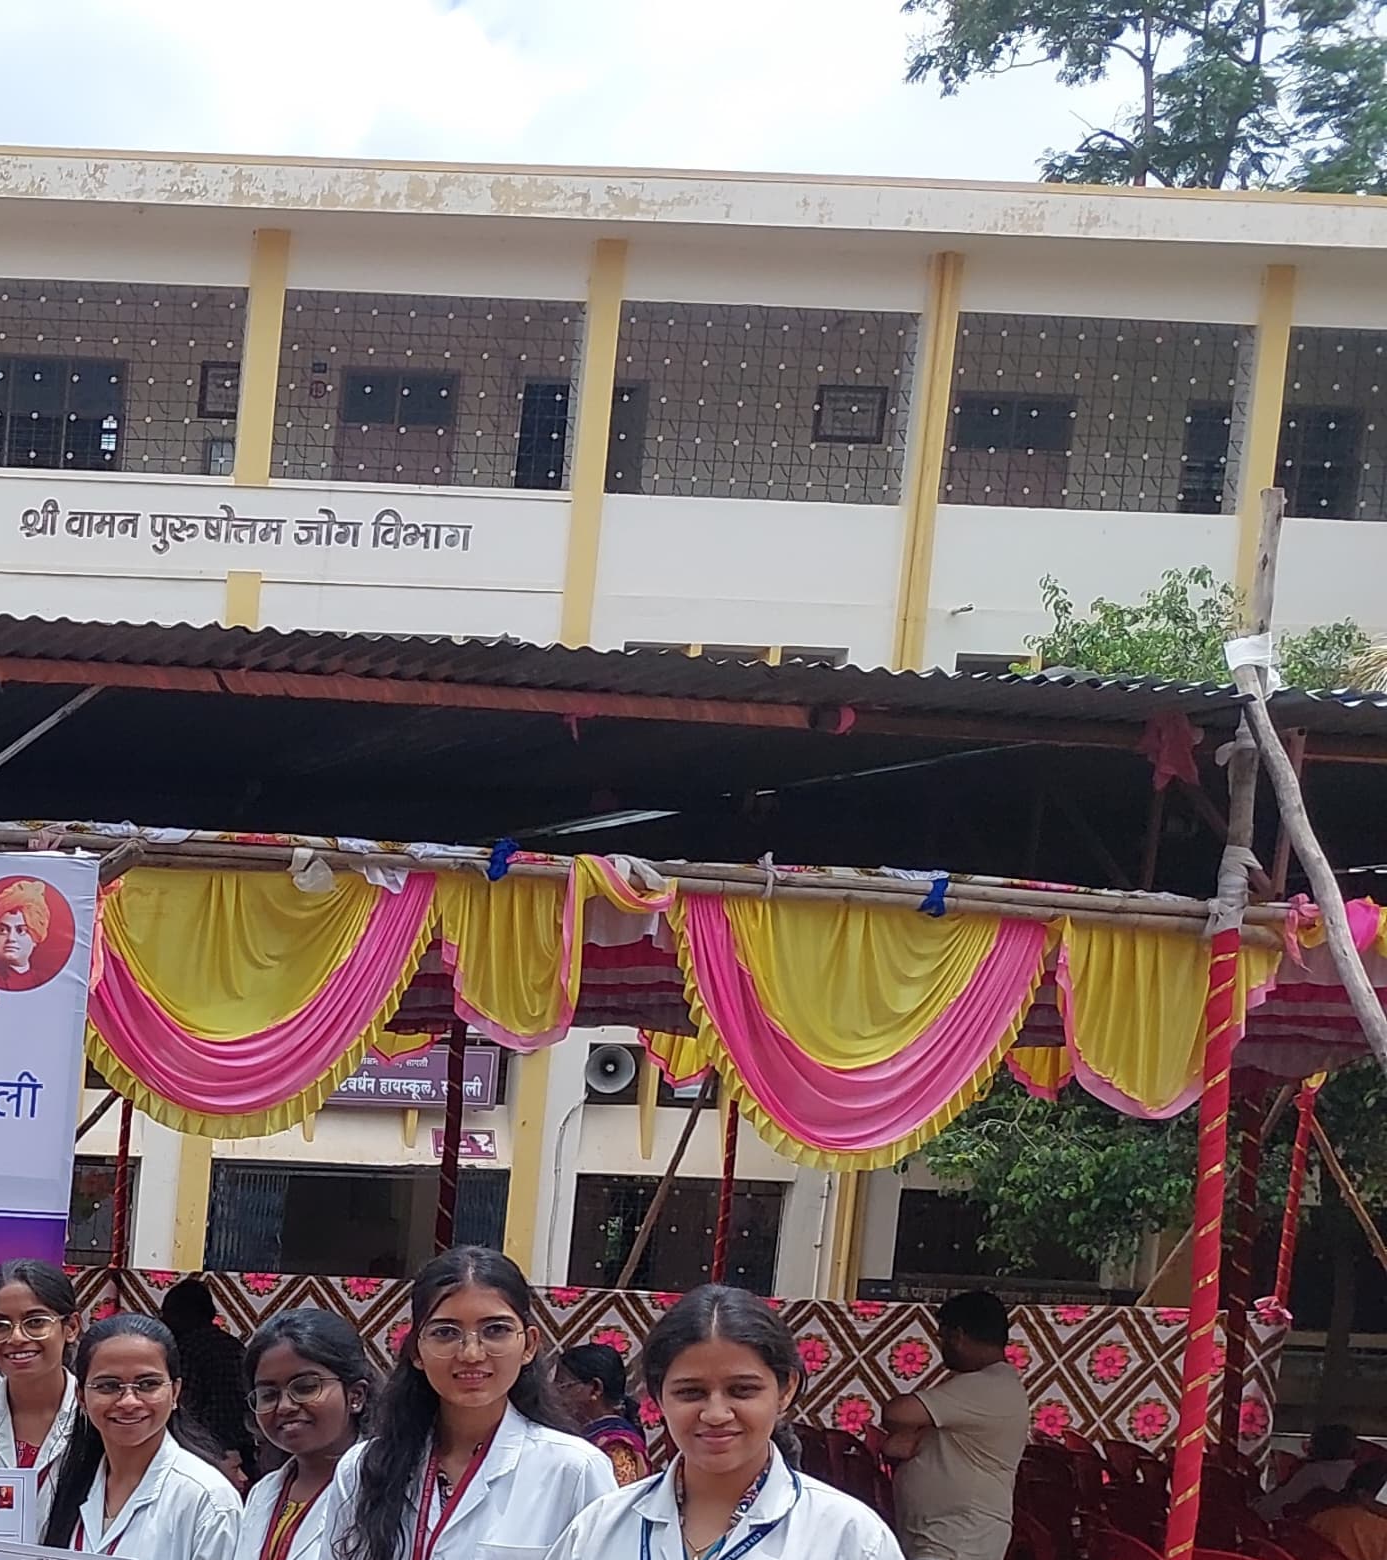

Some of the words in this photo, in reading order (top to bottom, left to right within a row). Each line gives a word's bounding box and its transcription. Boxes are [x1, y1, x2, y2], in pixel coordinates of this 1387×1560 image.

[20, 499, 59, 538] श्री
[66, 511, 140, 539] वामन
[293, 508, 361, 548] जोग
[371, 509, 473, 552] विभाग
